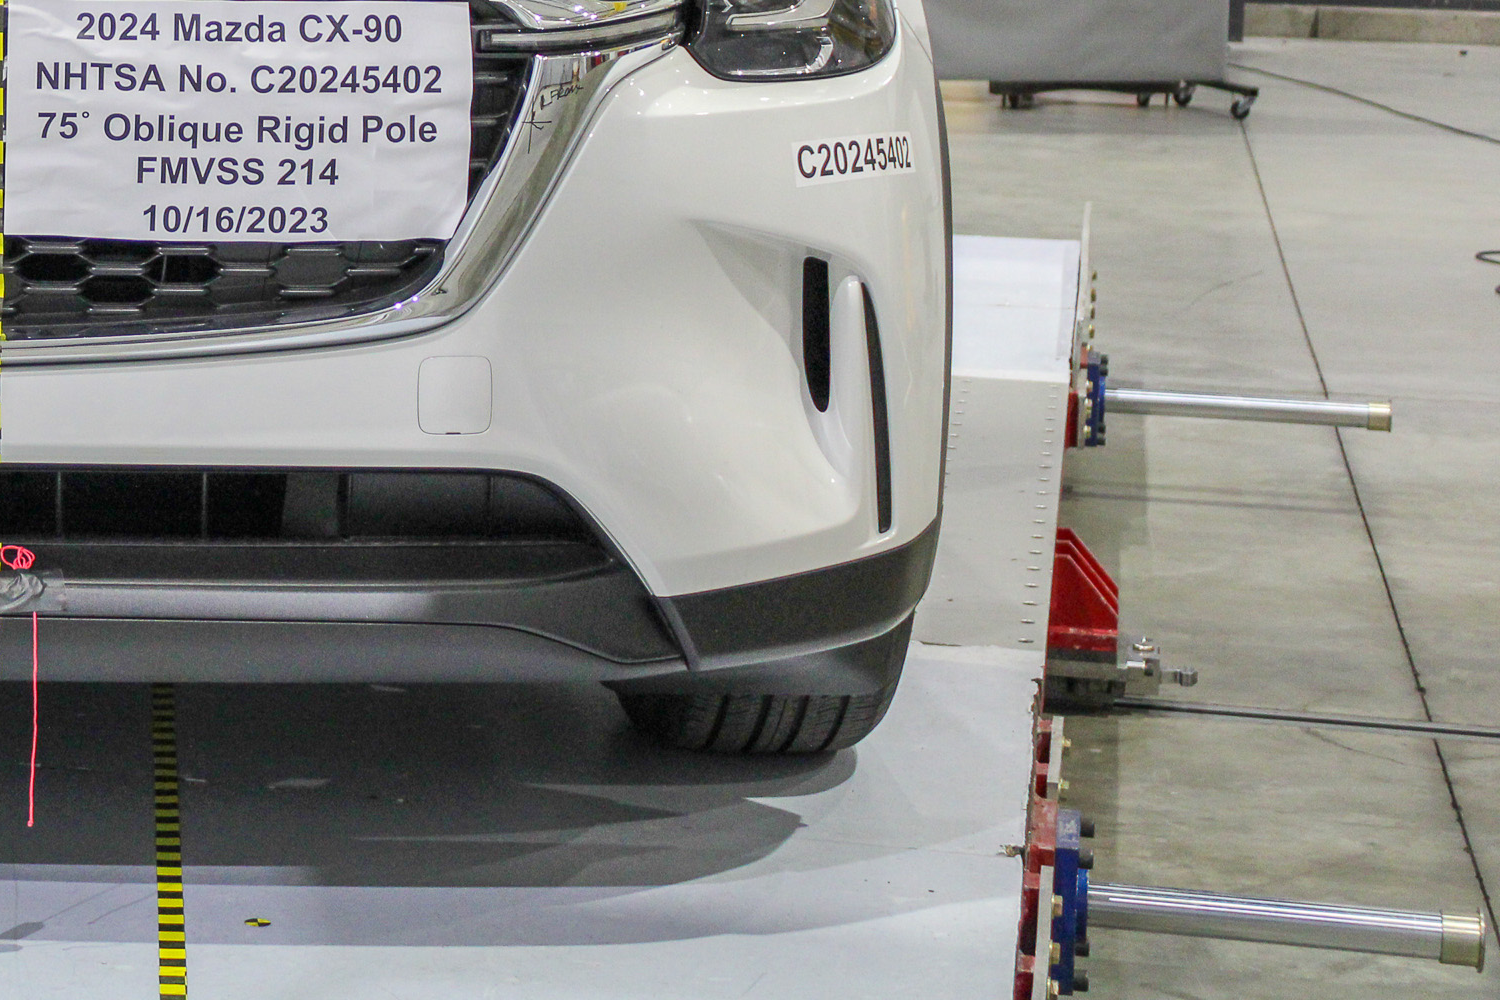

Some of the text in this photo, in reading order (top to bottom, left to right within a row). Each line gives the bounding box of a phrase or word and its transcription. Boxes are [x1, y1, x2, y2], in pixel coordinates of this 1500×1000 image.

[77, 13, 401, 42] 2024 Mazda CX-90
[37, 62, 441, 93] NHTSA No. C20245402
[104, 113, 243, 149] Oblique
[258, 116, 348, 150] Rigid
[363, 115, 437, 143] Pole
[137, 157, 338, 185] FMVSS 214
[797, 136, 912, 179] C20245402
[144, 205, 327, 233] 10/16/2023
